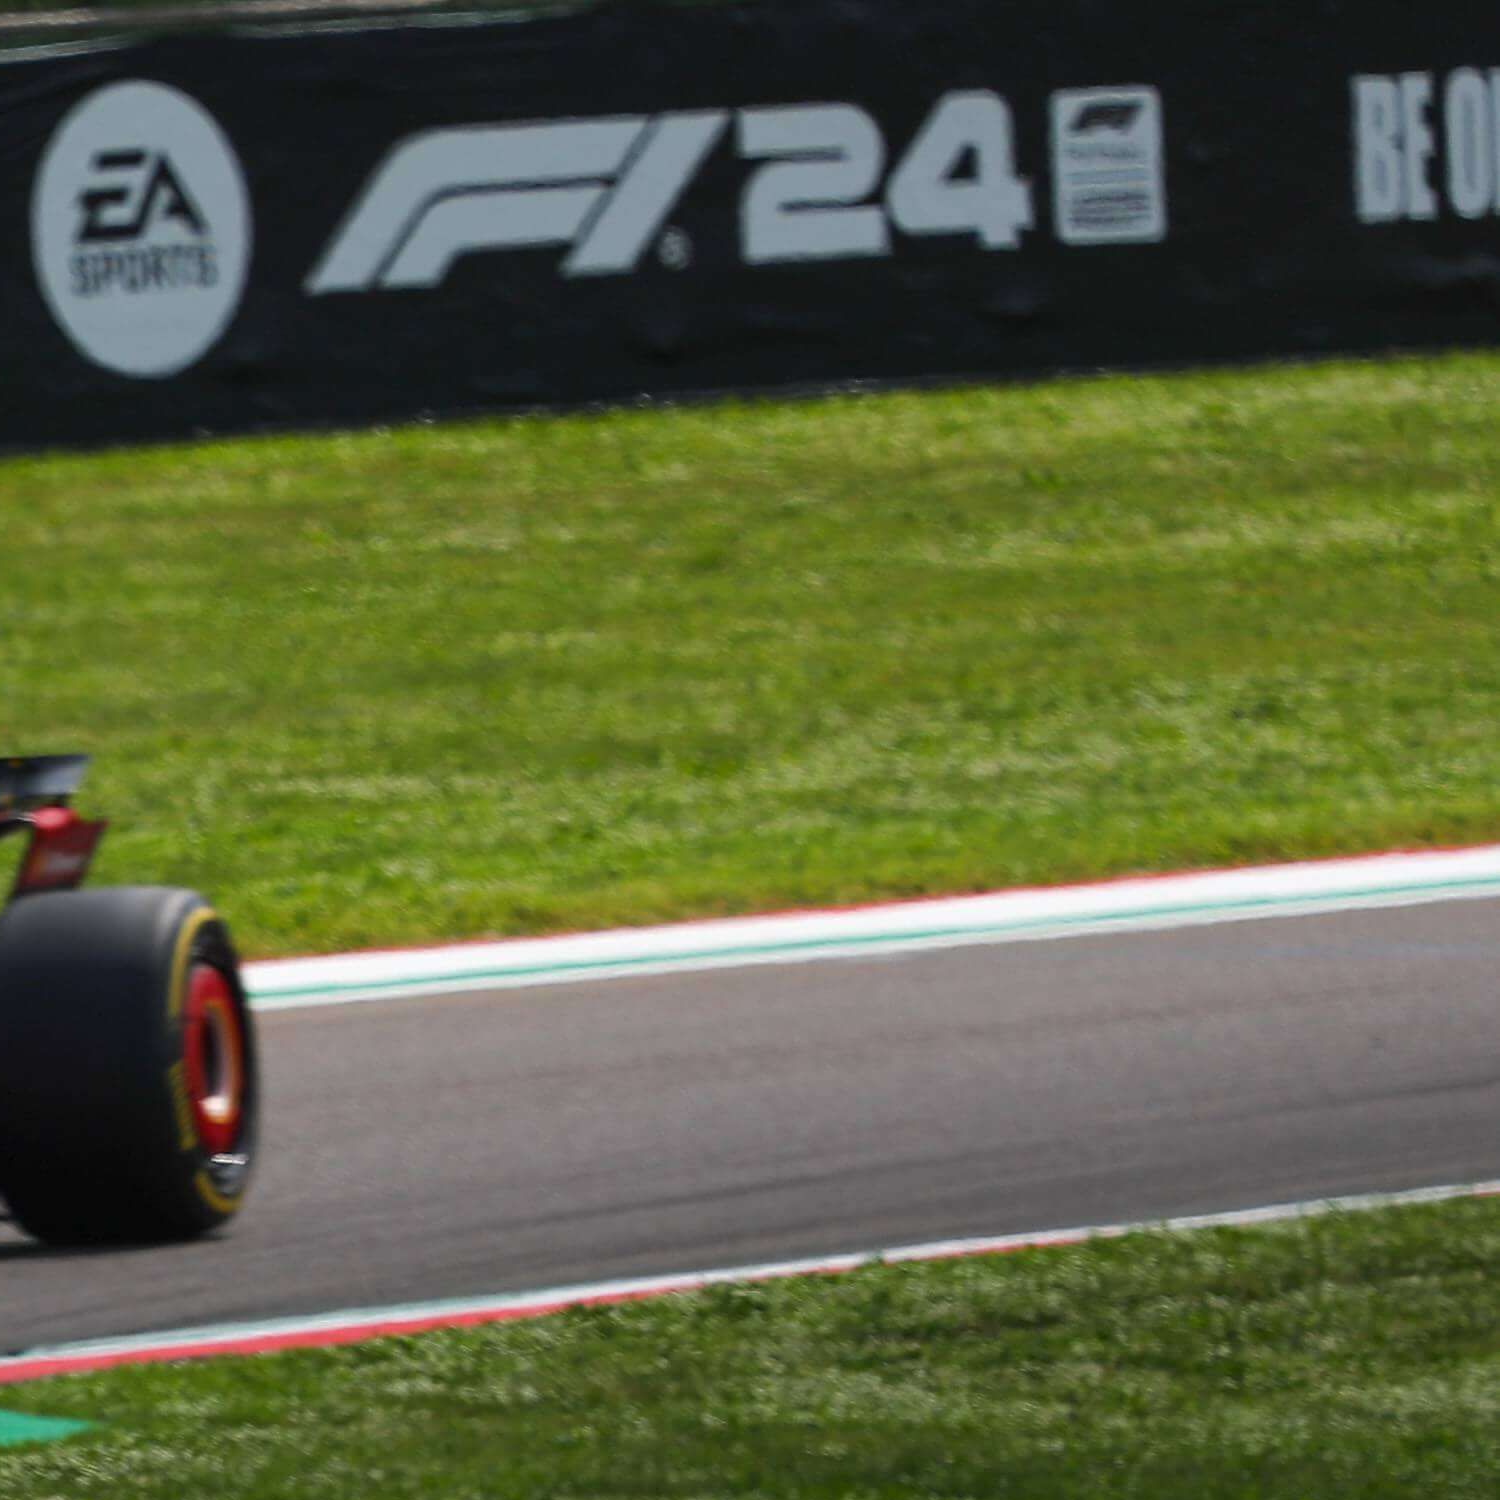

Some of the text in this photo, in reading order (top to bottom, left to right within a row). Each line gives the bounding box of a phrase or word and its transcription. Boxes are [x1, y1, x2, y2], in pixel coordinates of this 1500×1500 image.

[76, 147, 207, 242] EA
[304, 89, 1034, 295] F1 24
[1350, 66, 1500, 224] BE O
[69, 244, 218, 297] SPORTS
